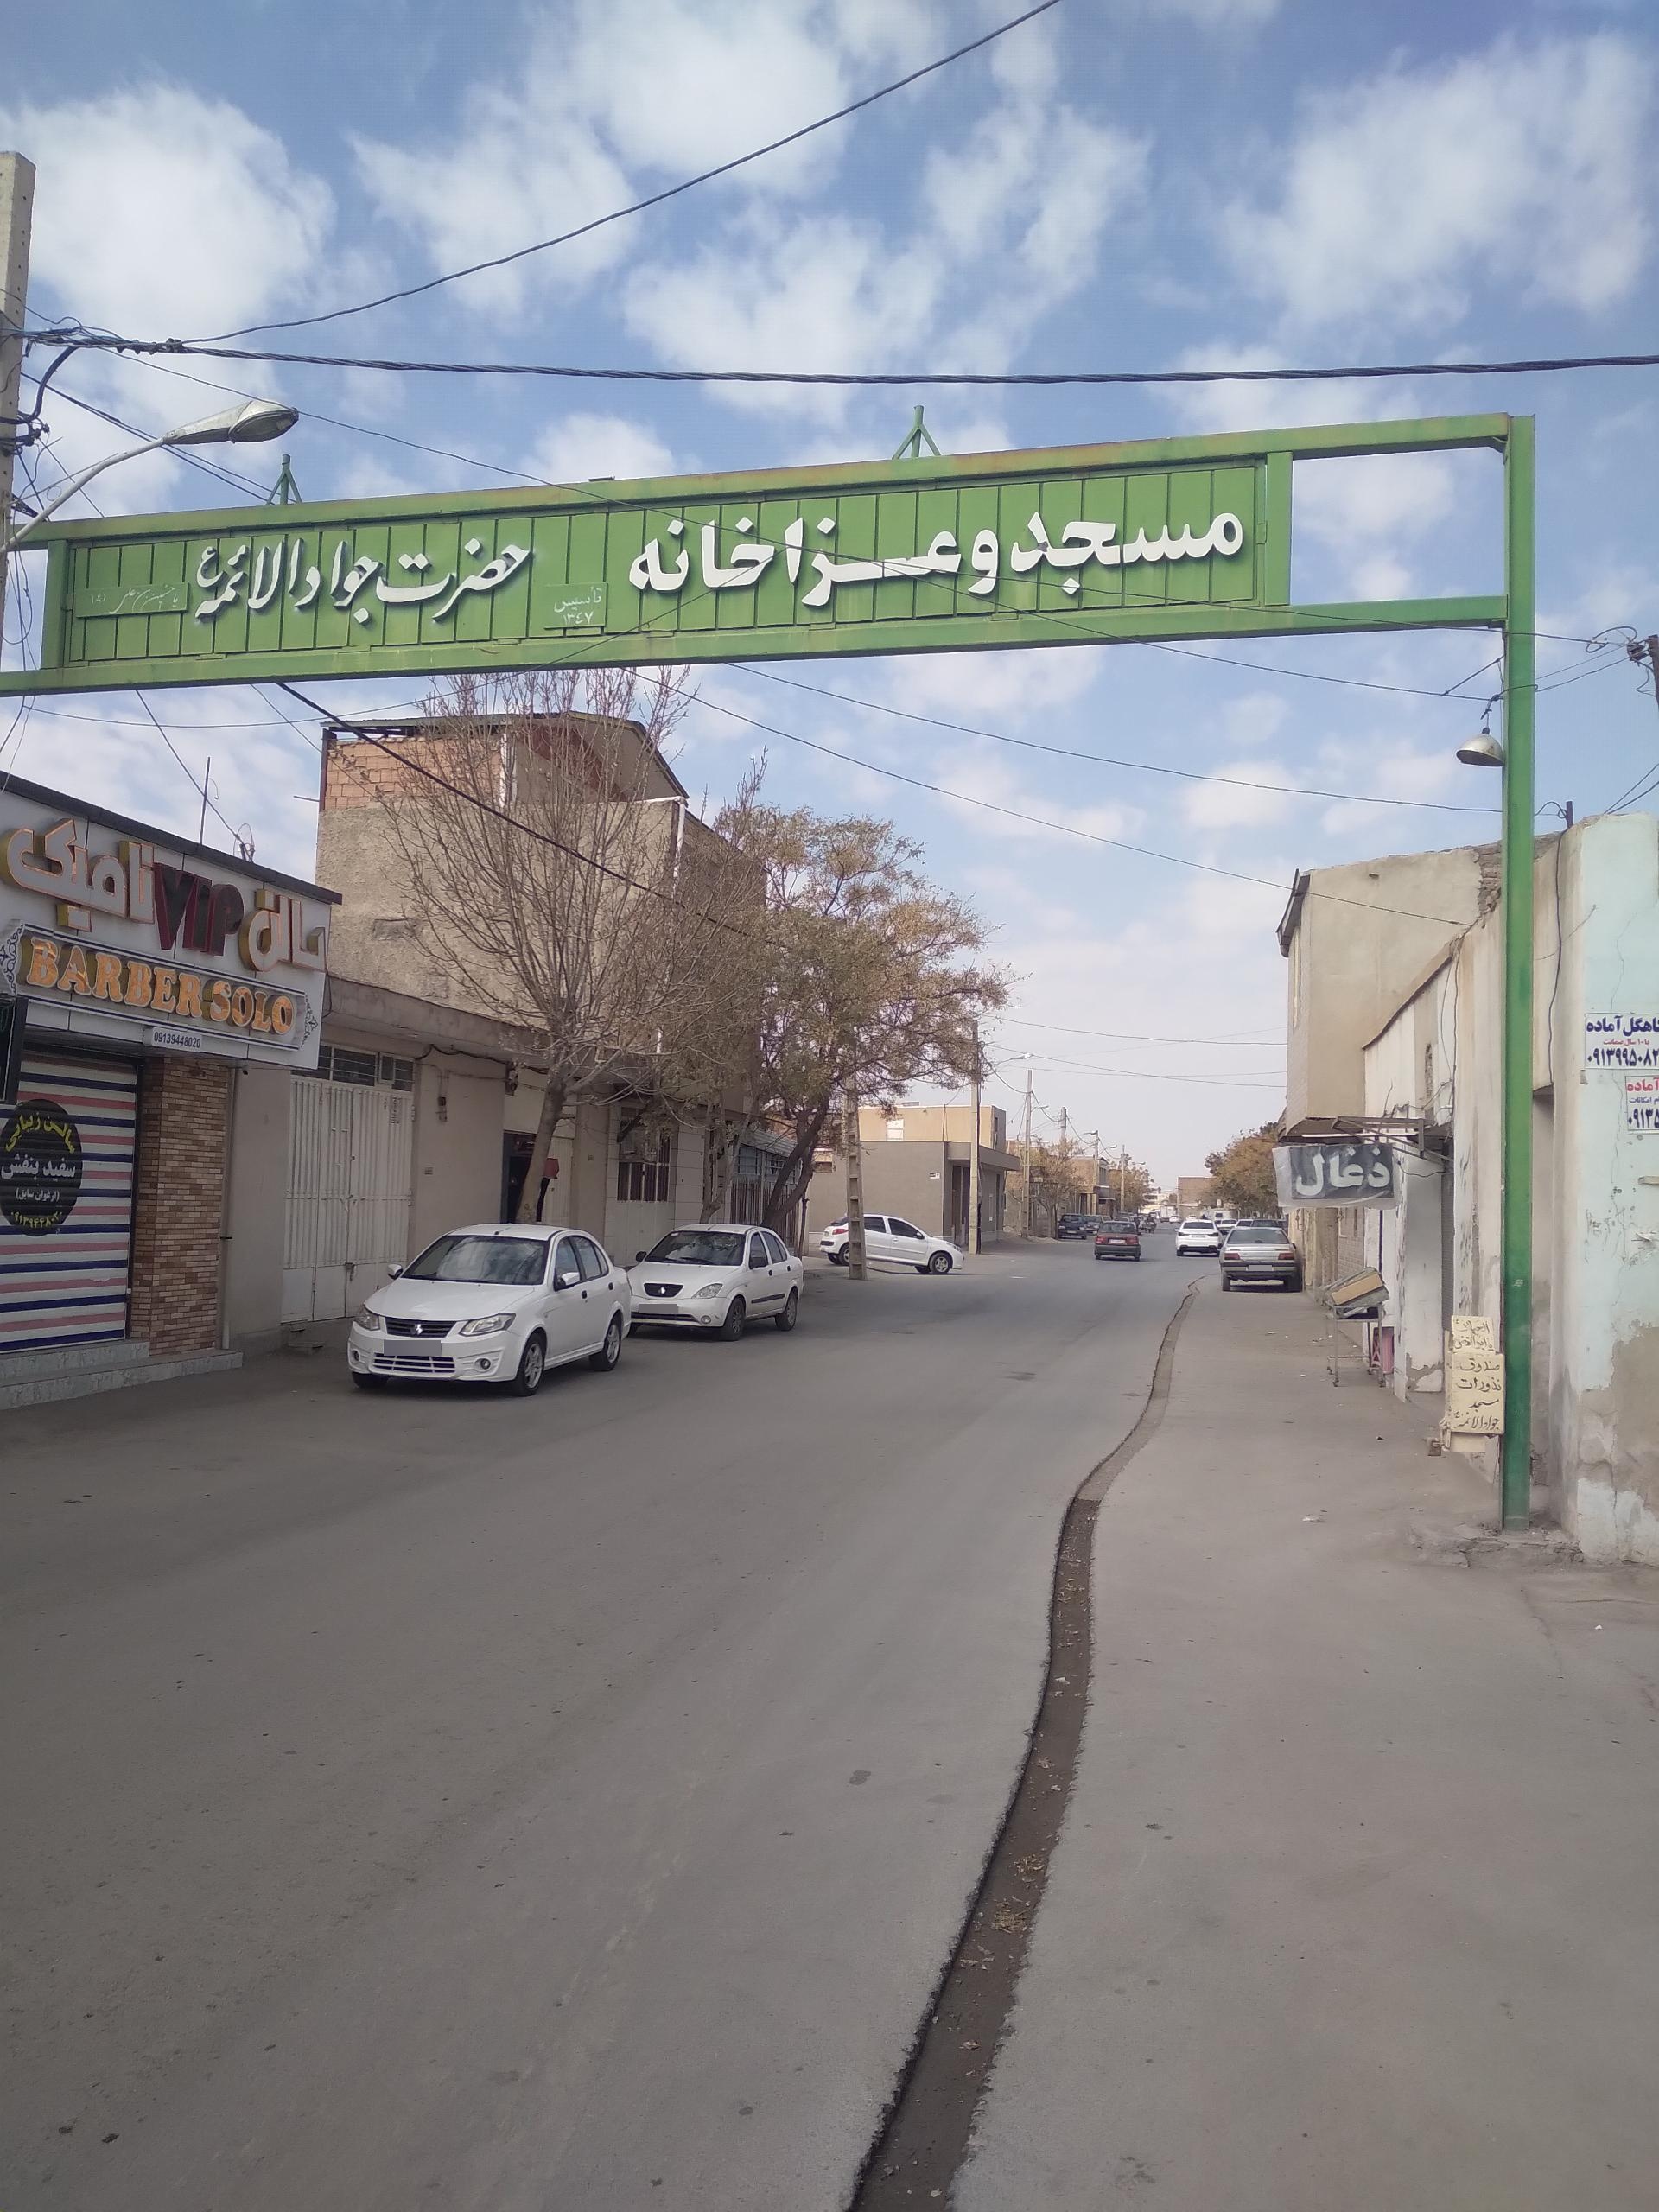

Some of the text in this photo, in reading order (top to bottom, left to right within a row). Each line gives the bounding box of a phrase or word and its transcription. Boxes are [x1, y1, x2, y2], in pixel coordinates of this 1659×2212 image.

[293, 540, 383, 624] جواد
[375, 537, 534, 621] حضرت
[966, 529, 999, 594] و
[1009, 511, 1244, 595] مسجد
[152, 862, 245, 957] VIP
[24, 936, 296, 1035] BARBER SOLO
[154, 1031, 201, 1049] 09139448020
[1586, 1015, 1623, 1033] آماده
[1, 1153, 76, 1182] سفید بنفش
[1295, 1146, 1391, 1197] ذغال
[1456, 1377, 1502, 1392] نذورات
[1460, 1357, 1500, 1373] صندوق
